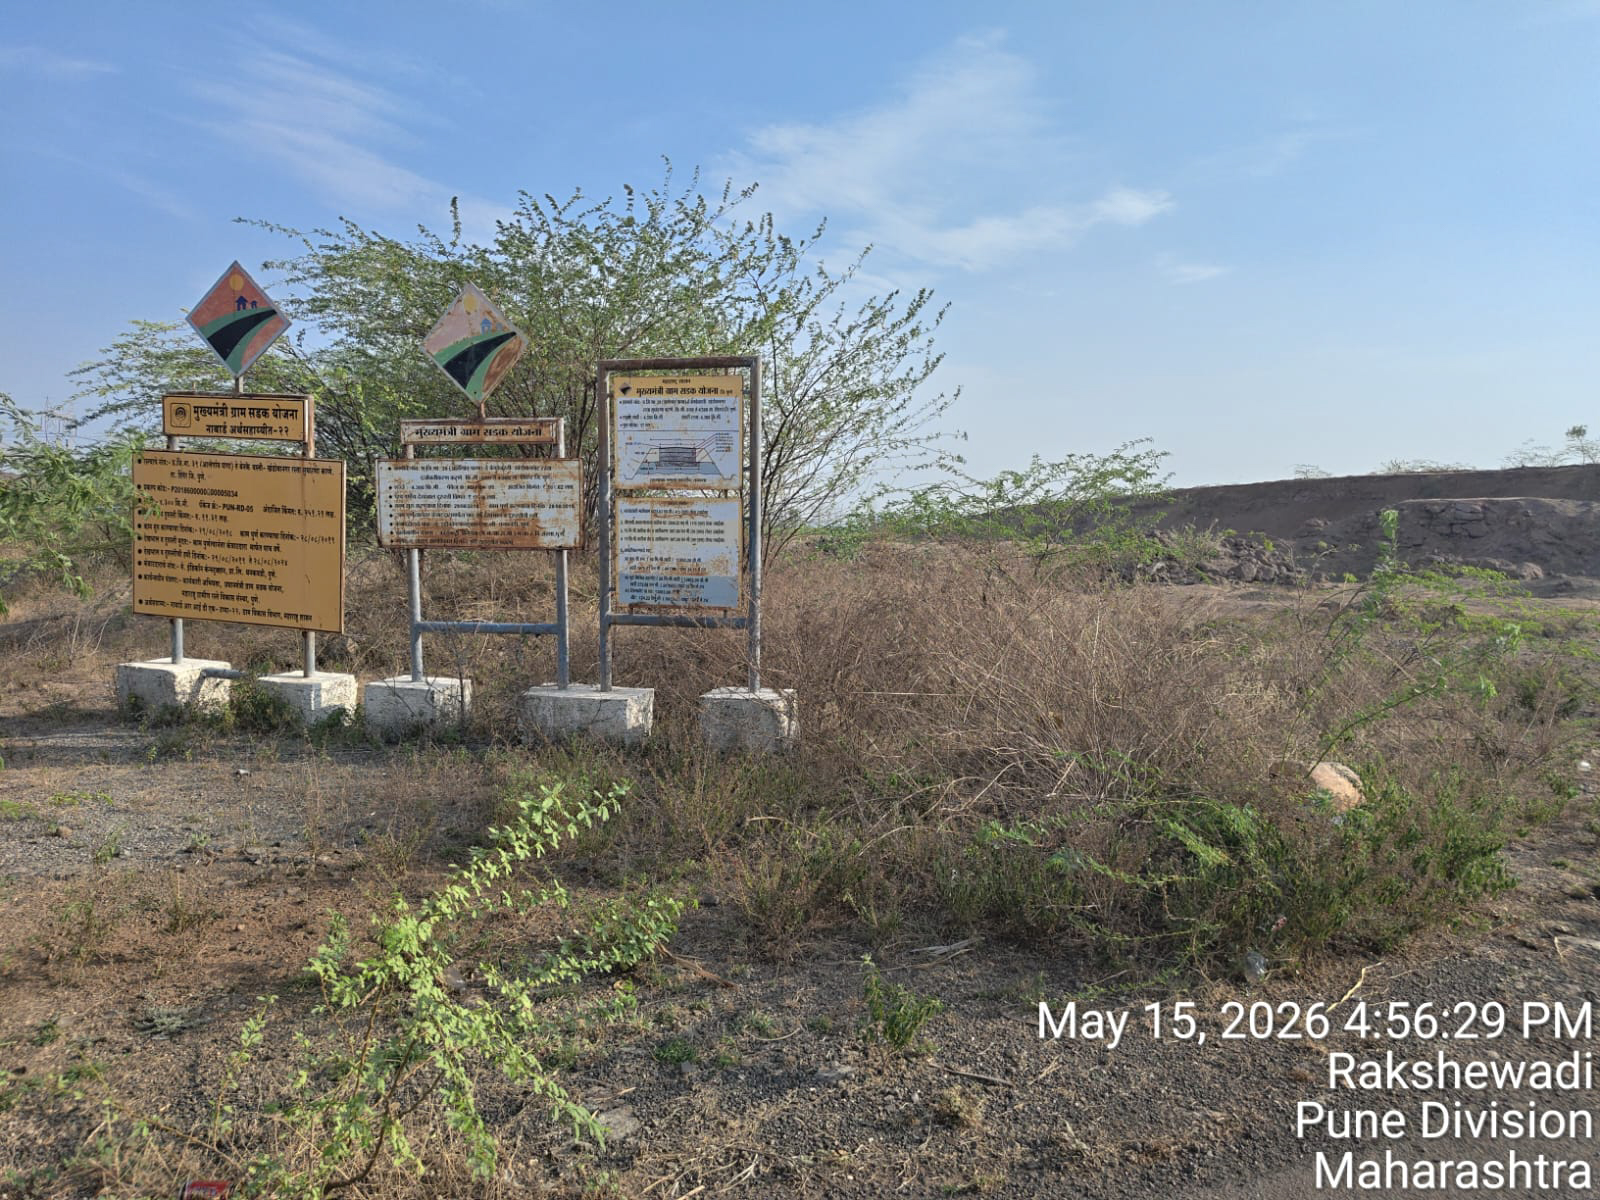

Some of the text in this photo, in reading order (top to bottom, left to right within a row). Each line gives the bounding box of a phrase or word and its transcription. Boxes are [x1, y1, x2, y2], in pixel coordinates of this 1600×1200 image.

[636, 386, 663, 397] मुख्यमंत्री
[698, 385, 718, 395] योजना
[193, 402, 298, 421] मुख्यमंत्री ग्राम सडक योजना
